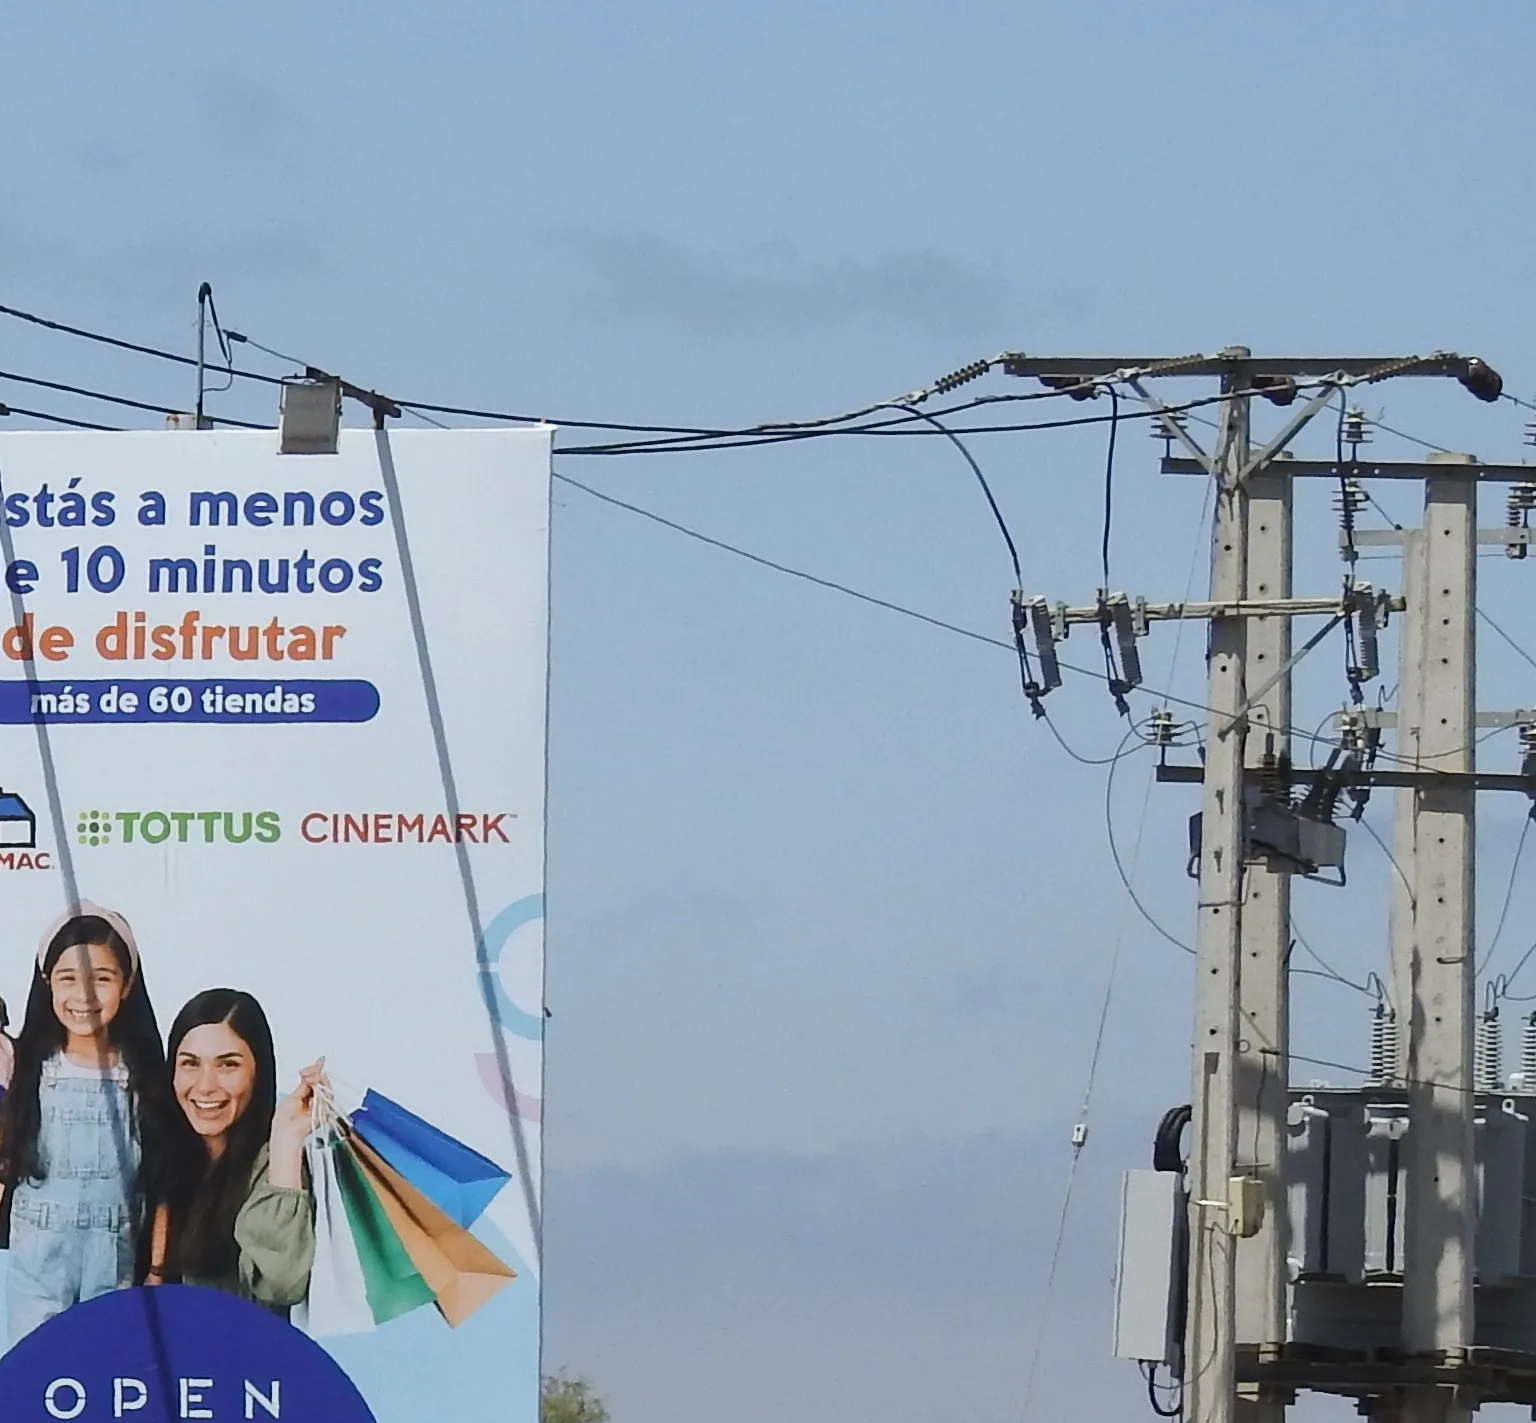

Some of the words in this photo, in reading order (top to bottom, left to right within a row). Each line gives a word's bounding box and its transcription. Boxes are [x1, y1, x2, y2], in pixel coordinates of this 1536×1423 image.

[137, 490, 166, 526] a
[189, 490, 384, 526] menos
[61, 545, 125, 593] 10
[148, 544, 383, 593] minutos
[2, 611, 74, 660] de
[95, 611, 347, 660] disfrutar
[31, 686, 89, 713] más
[99, 686, 138, 713] de
[149, 686, 192, 713] 60
[201, 686, 315, 713] tiendas
[116, 811, 281, 844] TOTTUS
[301, 811, 511, 844] CINEMARK
[45, 1377, 280, 1419] OPEN
